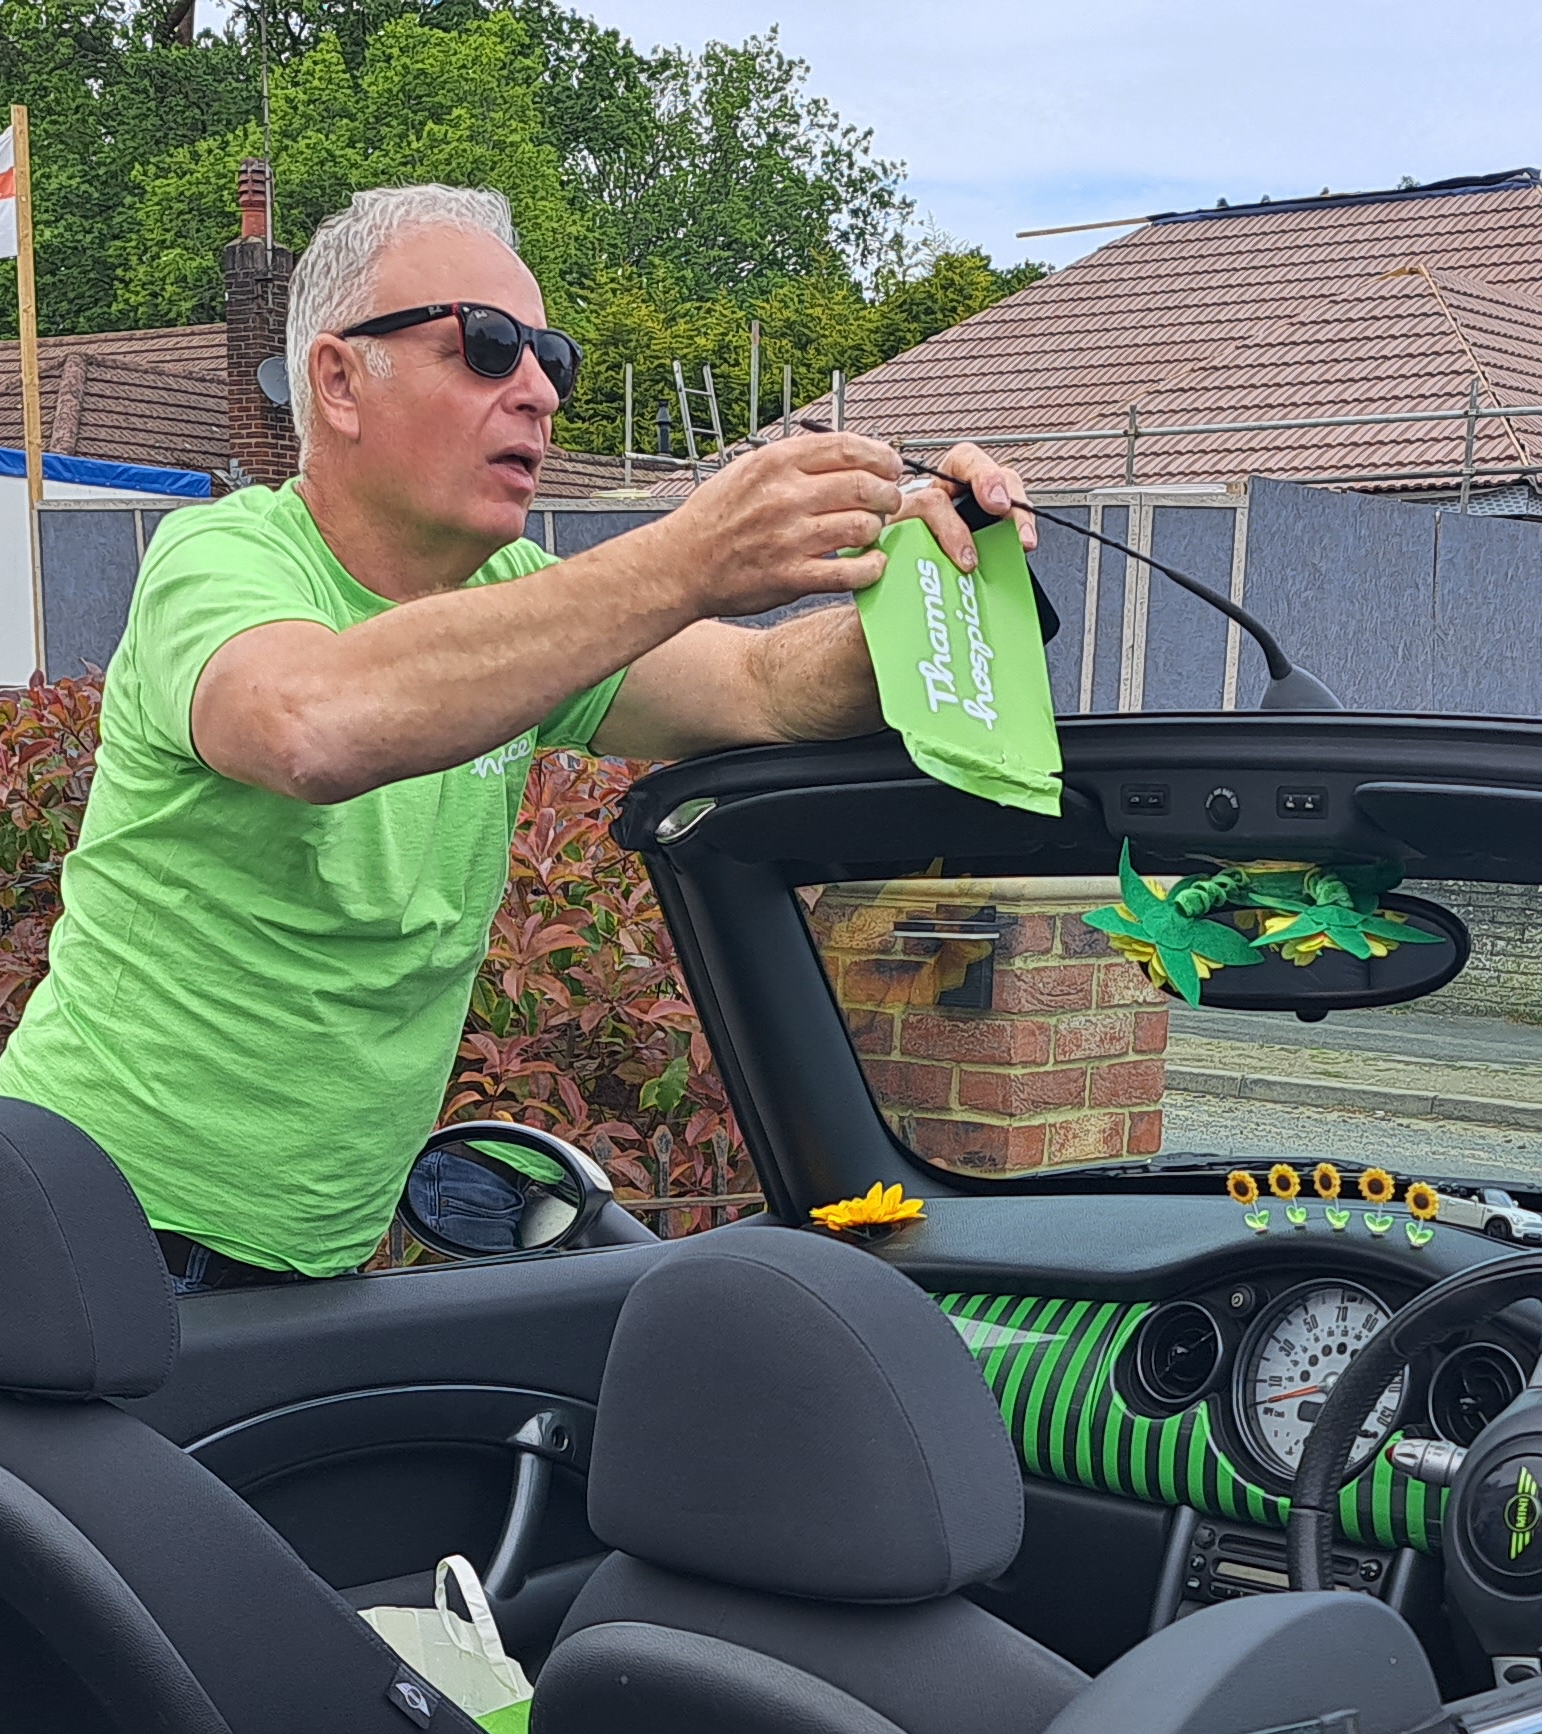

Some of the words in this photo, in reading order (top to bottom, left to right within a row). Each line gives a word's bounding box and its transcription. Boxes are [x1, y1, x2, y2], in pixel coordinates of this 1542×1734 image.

[916, 558, 958, 713] Thames
[956, 574, 997, 731] hospice
[1303, 1314, 1320, 1333] 50
[1335, 1306, 1349, 1323] 70
[1278, 1338, 1296, 1358] 30
[1515, 1497, 1530, 1529] MINI
